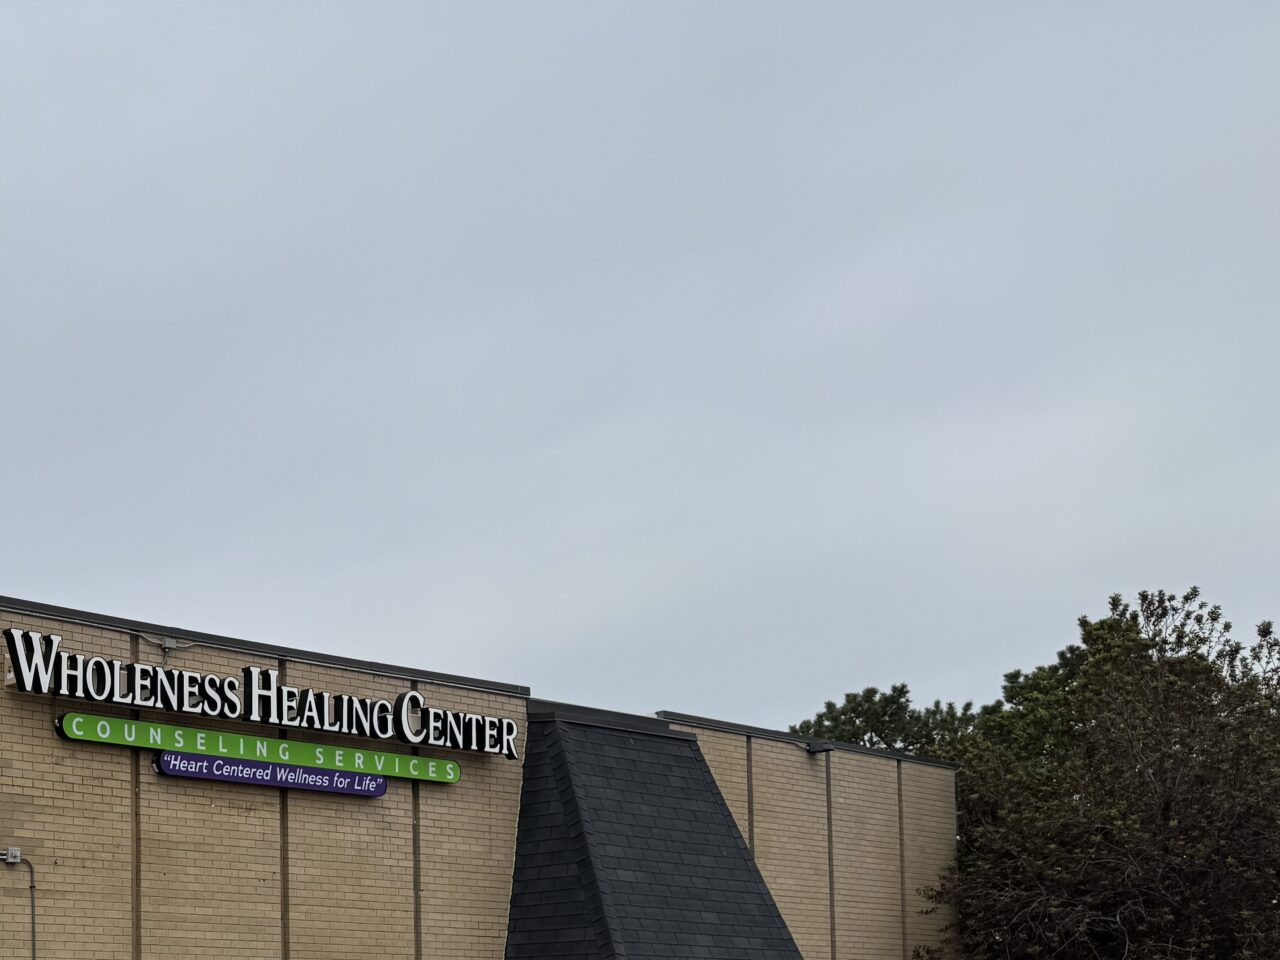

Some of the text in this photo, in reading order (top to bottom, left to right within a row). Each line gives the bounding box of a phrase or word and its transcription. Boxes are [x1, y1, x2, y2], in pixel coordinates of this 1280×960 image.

[7, 628, 519, 760] WHOLENESS HEALING CENTER
[72, 717, 455, 780] COUNSELING SERVICES
[164, 754, 383, 792] “Heart Centered Wellness for Life”
